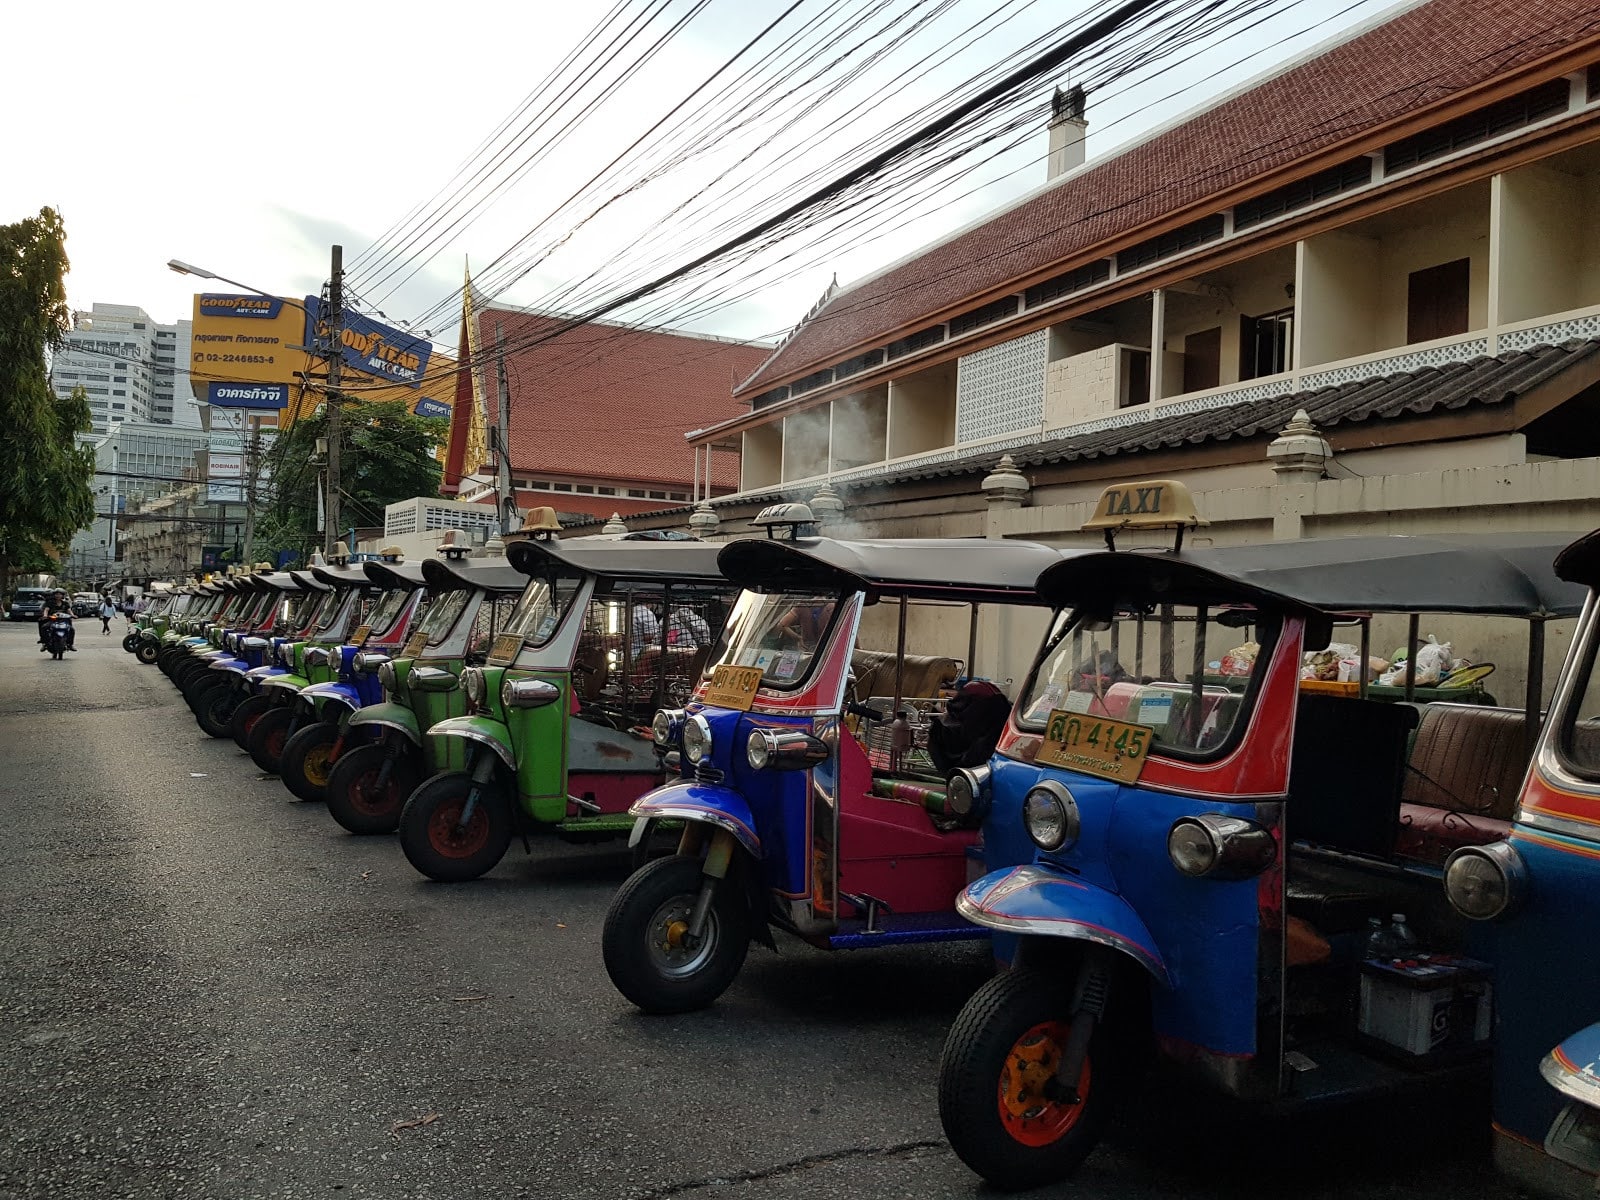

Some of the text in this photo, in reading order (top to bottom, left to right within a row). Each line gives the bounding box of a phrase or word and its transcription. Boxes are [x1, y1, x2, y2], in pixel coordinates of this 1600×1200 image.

[201, 297, 271, 309] GOODYEAR
[314, 319, 419, 371] GODYEAR
[216, 387, 281, 401] อาคารกิจจา
[1105, 487, 1164, 516] TAXI
[1050, 714, 1146, 758] สก 4145
